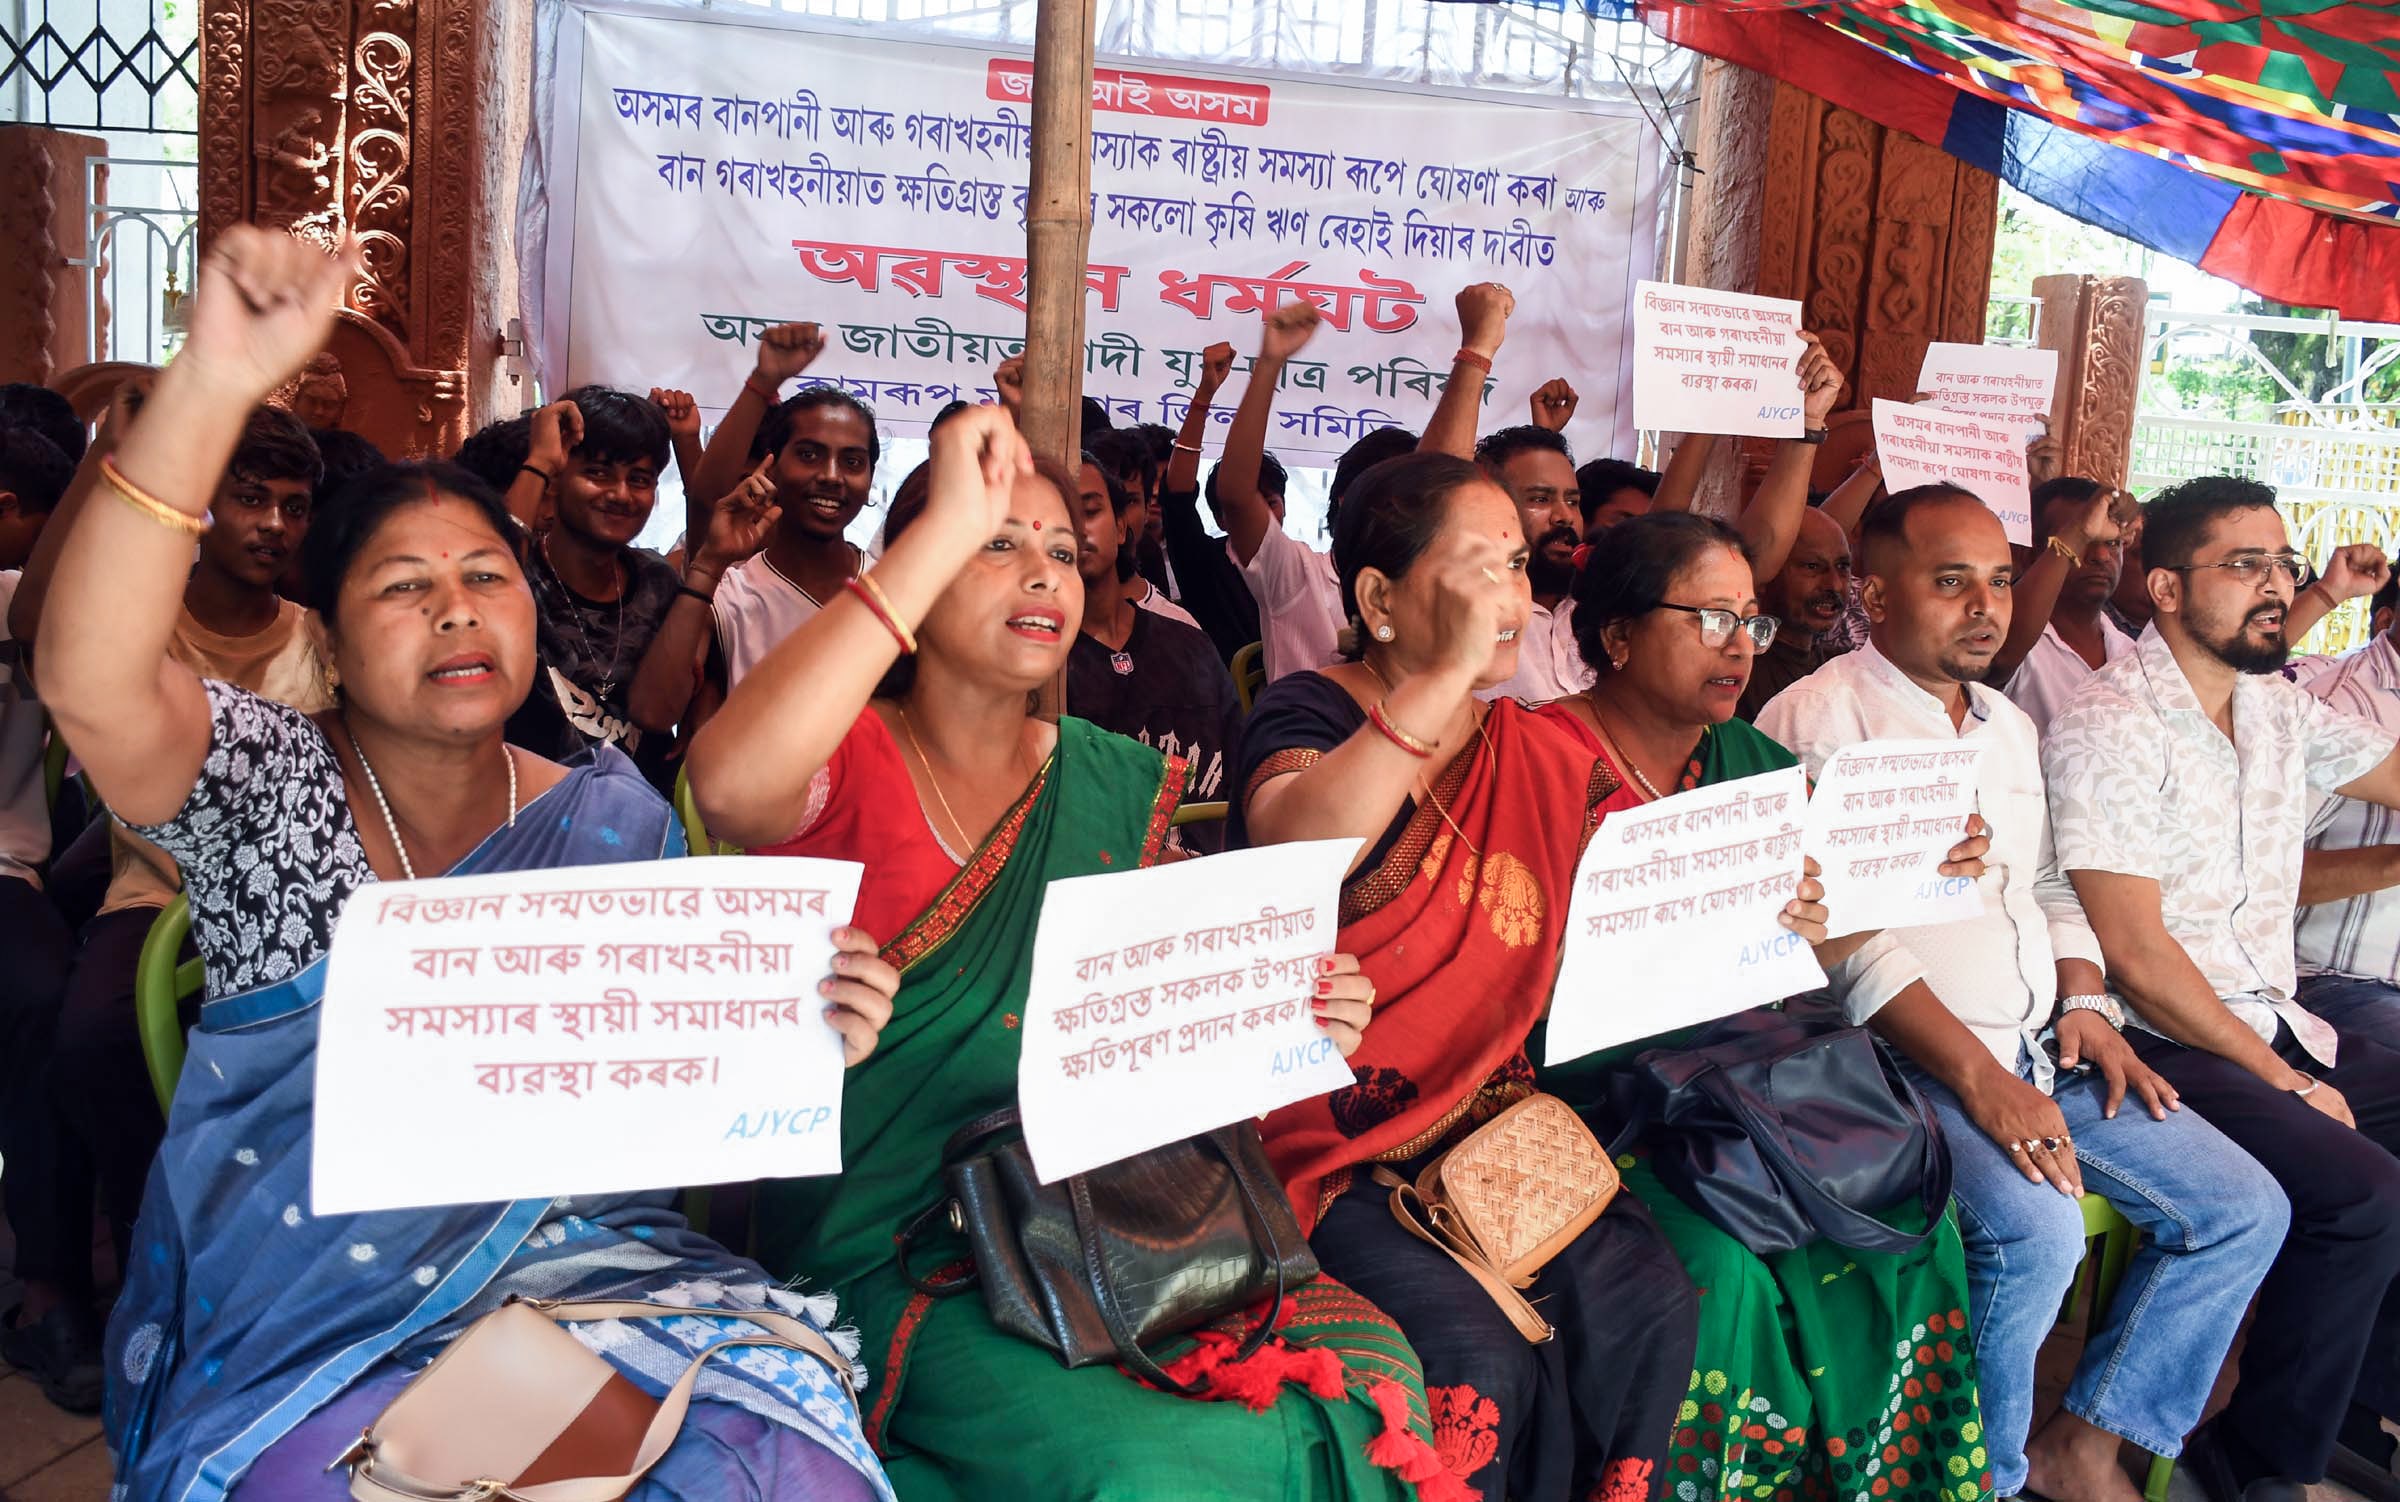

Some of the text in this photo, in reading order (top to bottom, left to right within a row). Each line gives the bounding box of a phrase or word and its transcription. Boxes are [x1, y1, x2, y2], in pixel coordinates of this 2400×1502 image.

[1164, 88, 1258, 120] অসম
[614, 88, 703, 129] অসমৰ
[713, 89, 821, 143] বানপানী
[830, 107, 895, 144] আৰু
[1259, 147, 1335, 190] সমস্যা
[1345, 156, 1407, 197] ৰূপে
[1416, 163, 1500, 206] ঘোষণা
[1508, 172, 1557, 212] কৰা
[1565, 187, 1608, 214] আৰু
[657, 154, 706, 193] বান
[716, 151, 886, 207] গৰাখহনীয়াত
[1107, 192, 1196, 238] সকলো
[1204, 189, 1256, 249] কৃষি
[1267, 209, 1308, 247] ঋণ
[1318, 203, 1397, 259] ৰেহাই
[1404, 209, 1476, 261] দিয়াৰ
[1482, 219, 1558, 268] দাবীত
[1757, 406, 1801, 420] AJYCP
[1999, 509, 2029, 525] AJYCP
[1622, 791, 1789, 846] অসমৰ বানপানী আৰু
[1587, 849, 1688, 896] গৰাখহনীয়া
[1692, 839, 1760, 873] সমস্যাক
[1914, 876, 1970, 900] AJYCP
[376, 892, 503, 926] বিজ্ঞান
[713, 887, 831, 919] অসমৰ
[1586, 870, 1796, 938] সমস্যা ৰূপে ঘোষণা কৰক
[411, 930, 794, 980] বান আৰু গৰাখহনীয়া
[1075, 905, 1316, 984] বান আৰু গৰাখহনীয়াত
[1737, 930, 1801, 967] AJYCP
[1160, 967, 1248, 1006] সকলক
[385, 987, 801, 1042] সমস্যাৰ স্থায়ী সমাধানৰ
[474, 1055, 720, 1100] ব্যৱস্থা কৰক।
[1271, 1036, 1333, 1078] AJYCP
[723, 1105, 833, 1144] AJYCP
